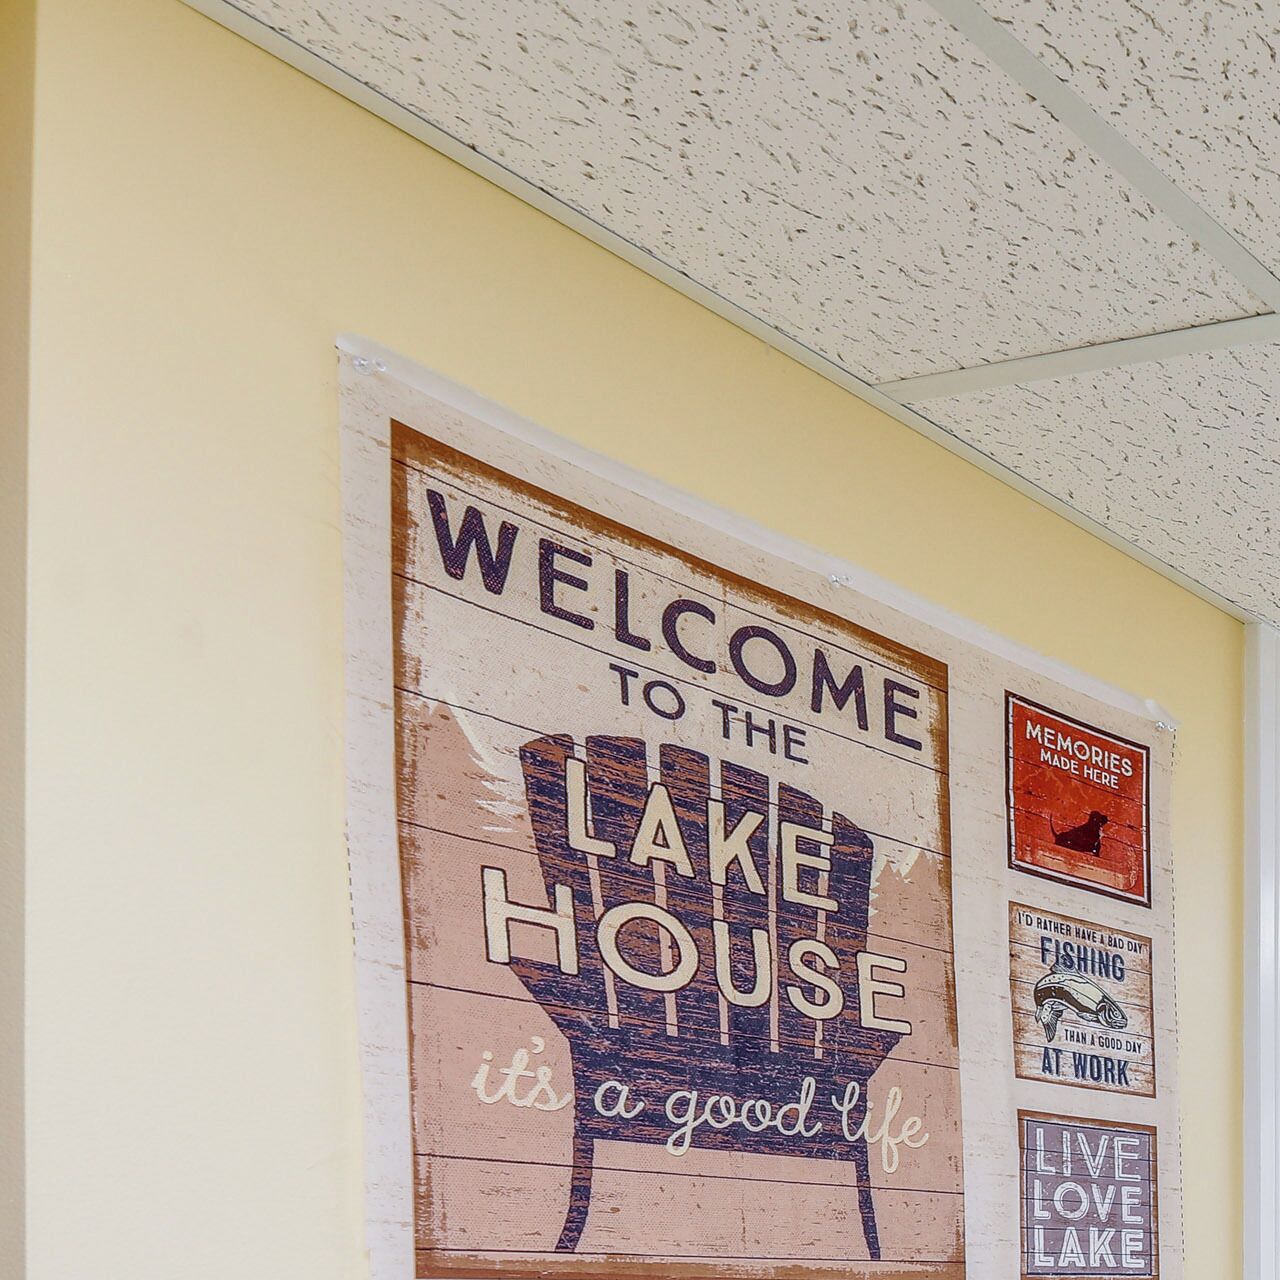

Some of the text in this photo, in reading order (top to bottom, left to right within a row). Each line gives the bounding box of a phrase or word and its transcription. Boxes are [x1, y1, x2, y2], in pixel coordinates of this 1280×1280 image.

[426, 488, 923, 751] WELCOME
[609, 662, 809, 765] TO THE
[1026, 719, 1133, 777] MEMORIES
[1040, 748, 1119, 789] MADE HERE
[565, 756, 839, 913] LAKE
[481, 864, 912, 1036] HOUSE
[1018, 912, 1142, 954] I'D RATHER HAVE A BAD DAY
[1040, 935, 1125, 982] FISHING
[1041, 1047, 1130, 1086] AT WORK
[1064, 1028, 1142, 1055] THAN A GOOD DAY
[471, 1036, 929, 1174] it's a good life
[1036, 1127, 1142, 1182] LIVE
[1033, 1179, 1144, 1224] LOVE
[1033, 1224, 1145, 1268] LAKE
